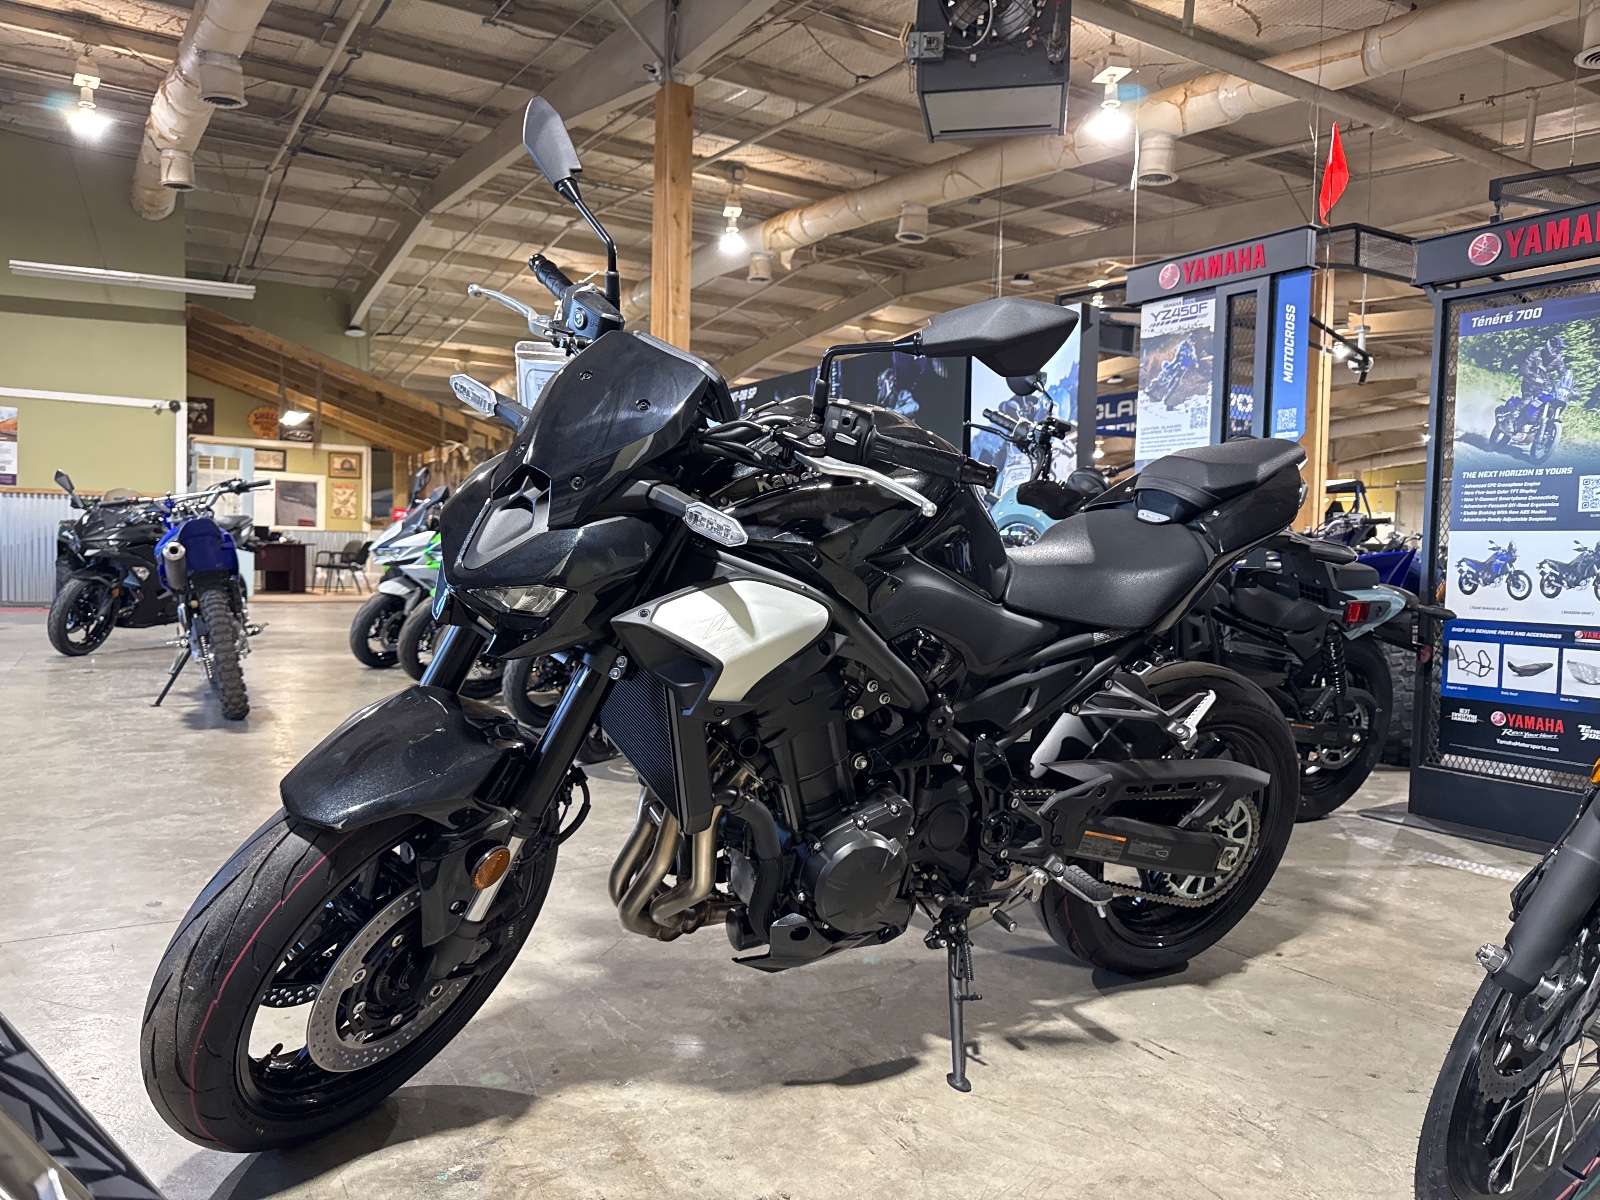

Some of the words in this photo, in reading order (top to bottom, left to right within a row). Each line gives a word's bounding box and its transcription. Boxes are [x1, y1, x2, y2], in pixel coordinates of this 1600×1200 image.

[1505, 211, 1600, 259] YAMA
[1182, 243, 1266, 285] YAMAHA
[1150, 302, 1208, 322] YZ450F
[1471, 311, 1514, 329] Ténéré
[1516, 307, 1543, 322] 700
[1283, 304, 1296, 384] MOTOCROSS
[1499, 469, 1534, 477] HORIZON
[1546, 467, 1574, 476] YOURS
[1584, 632, 1600, 640] YAM
[1507, 713, 1564, 734] YAMAHA
[1496, 738, 1560, 752] YamahaMotorsports.com
